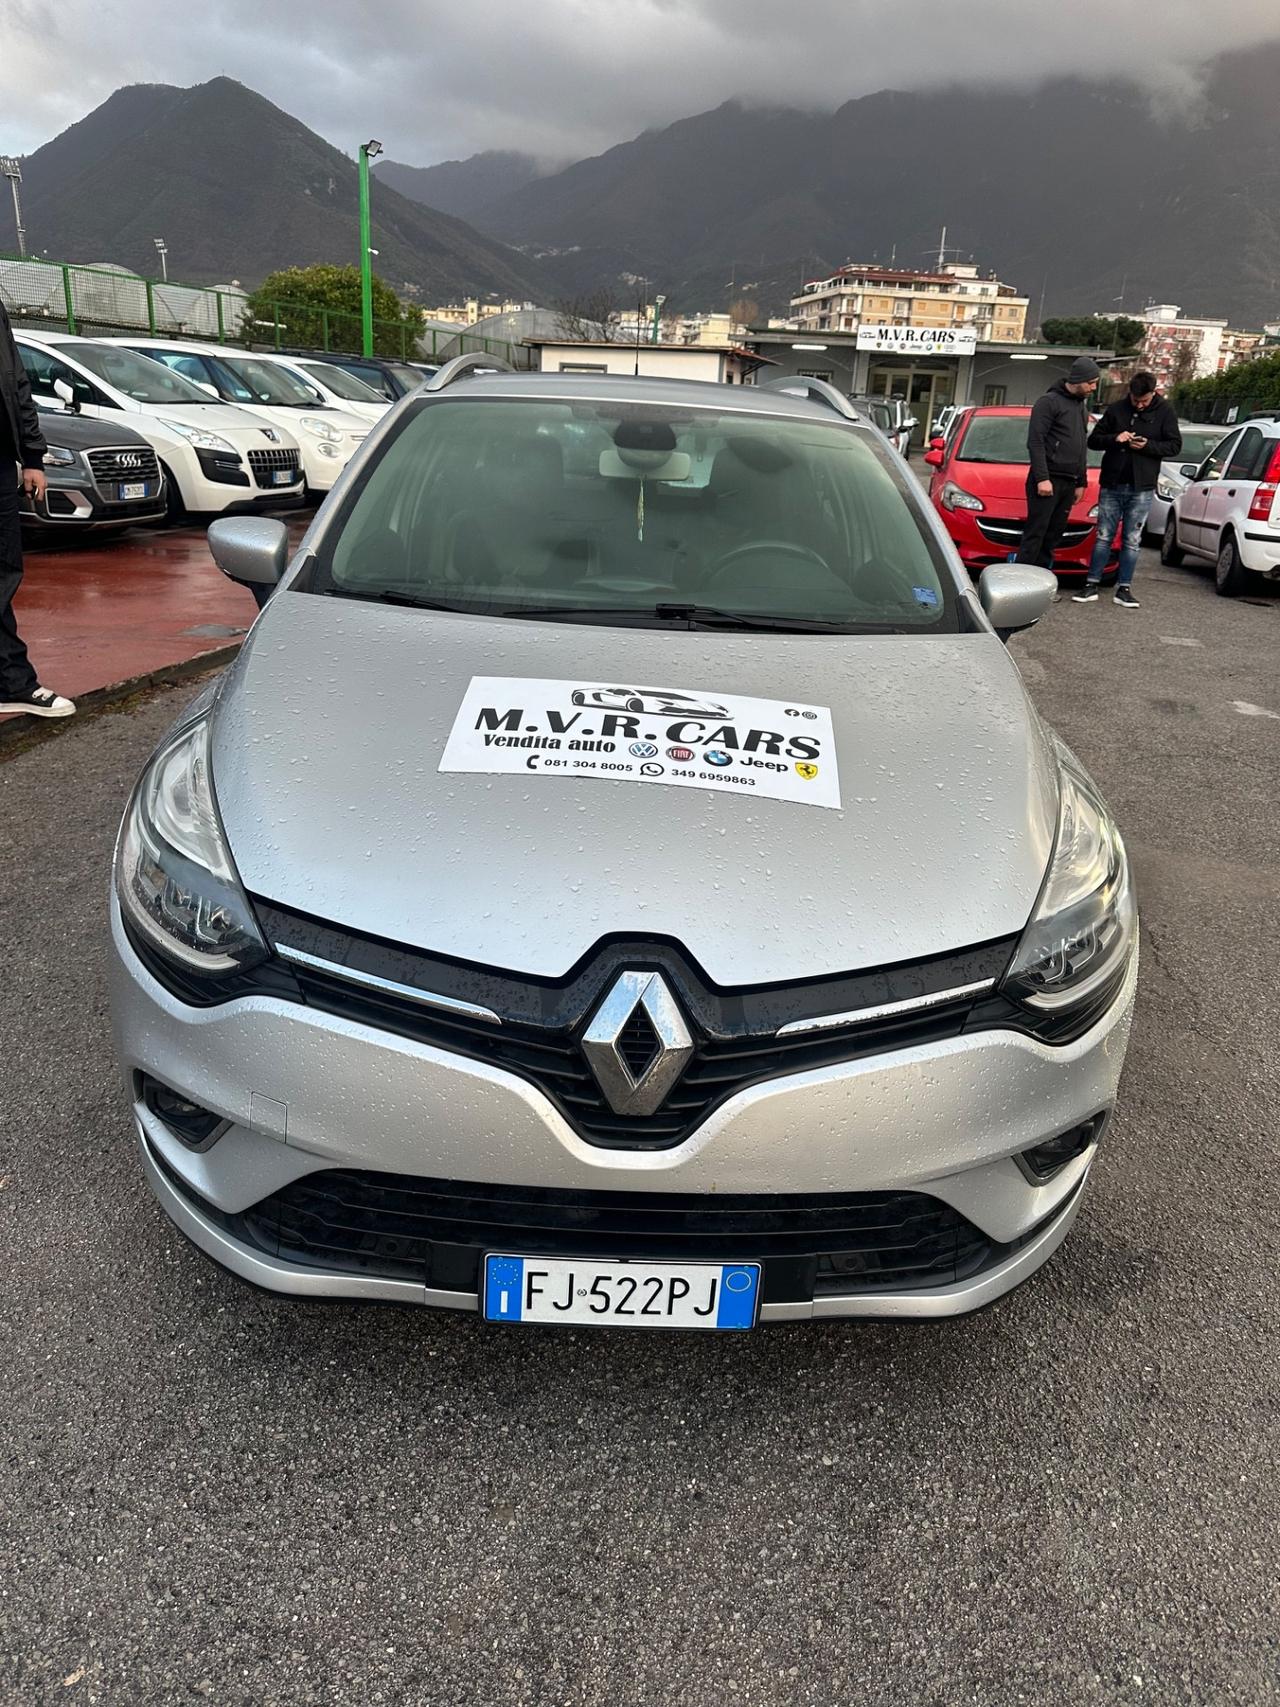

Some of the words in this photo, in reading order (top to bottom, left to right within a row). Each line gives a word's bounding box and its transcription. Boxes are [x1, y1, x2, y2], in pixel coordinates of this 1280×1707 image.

[483, 734, 561, 750] Vendita
[568, 738, 616, 754] auto
[544, 759, 568, 768] 081
[572, 760, 597, 769] 304
[600, 762, 633, 772] 8005
[740, 757, 788, 773] Jeep
[671, 769, 696, 779] 349
[699, 772, 756, 787] 6959863
